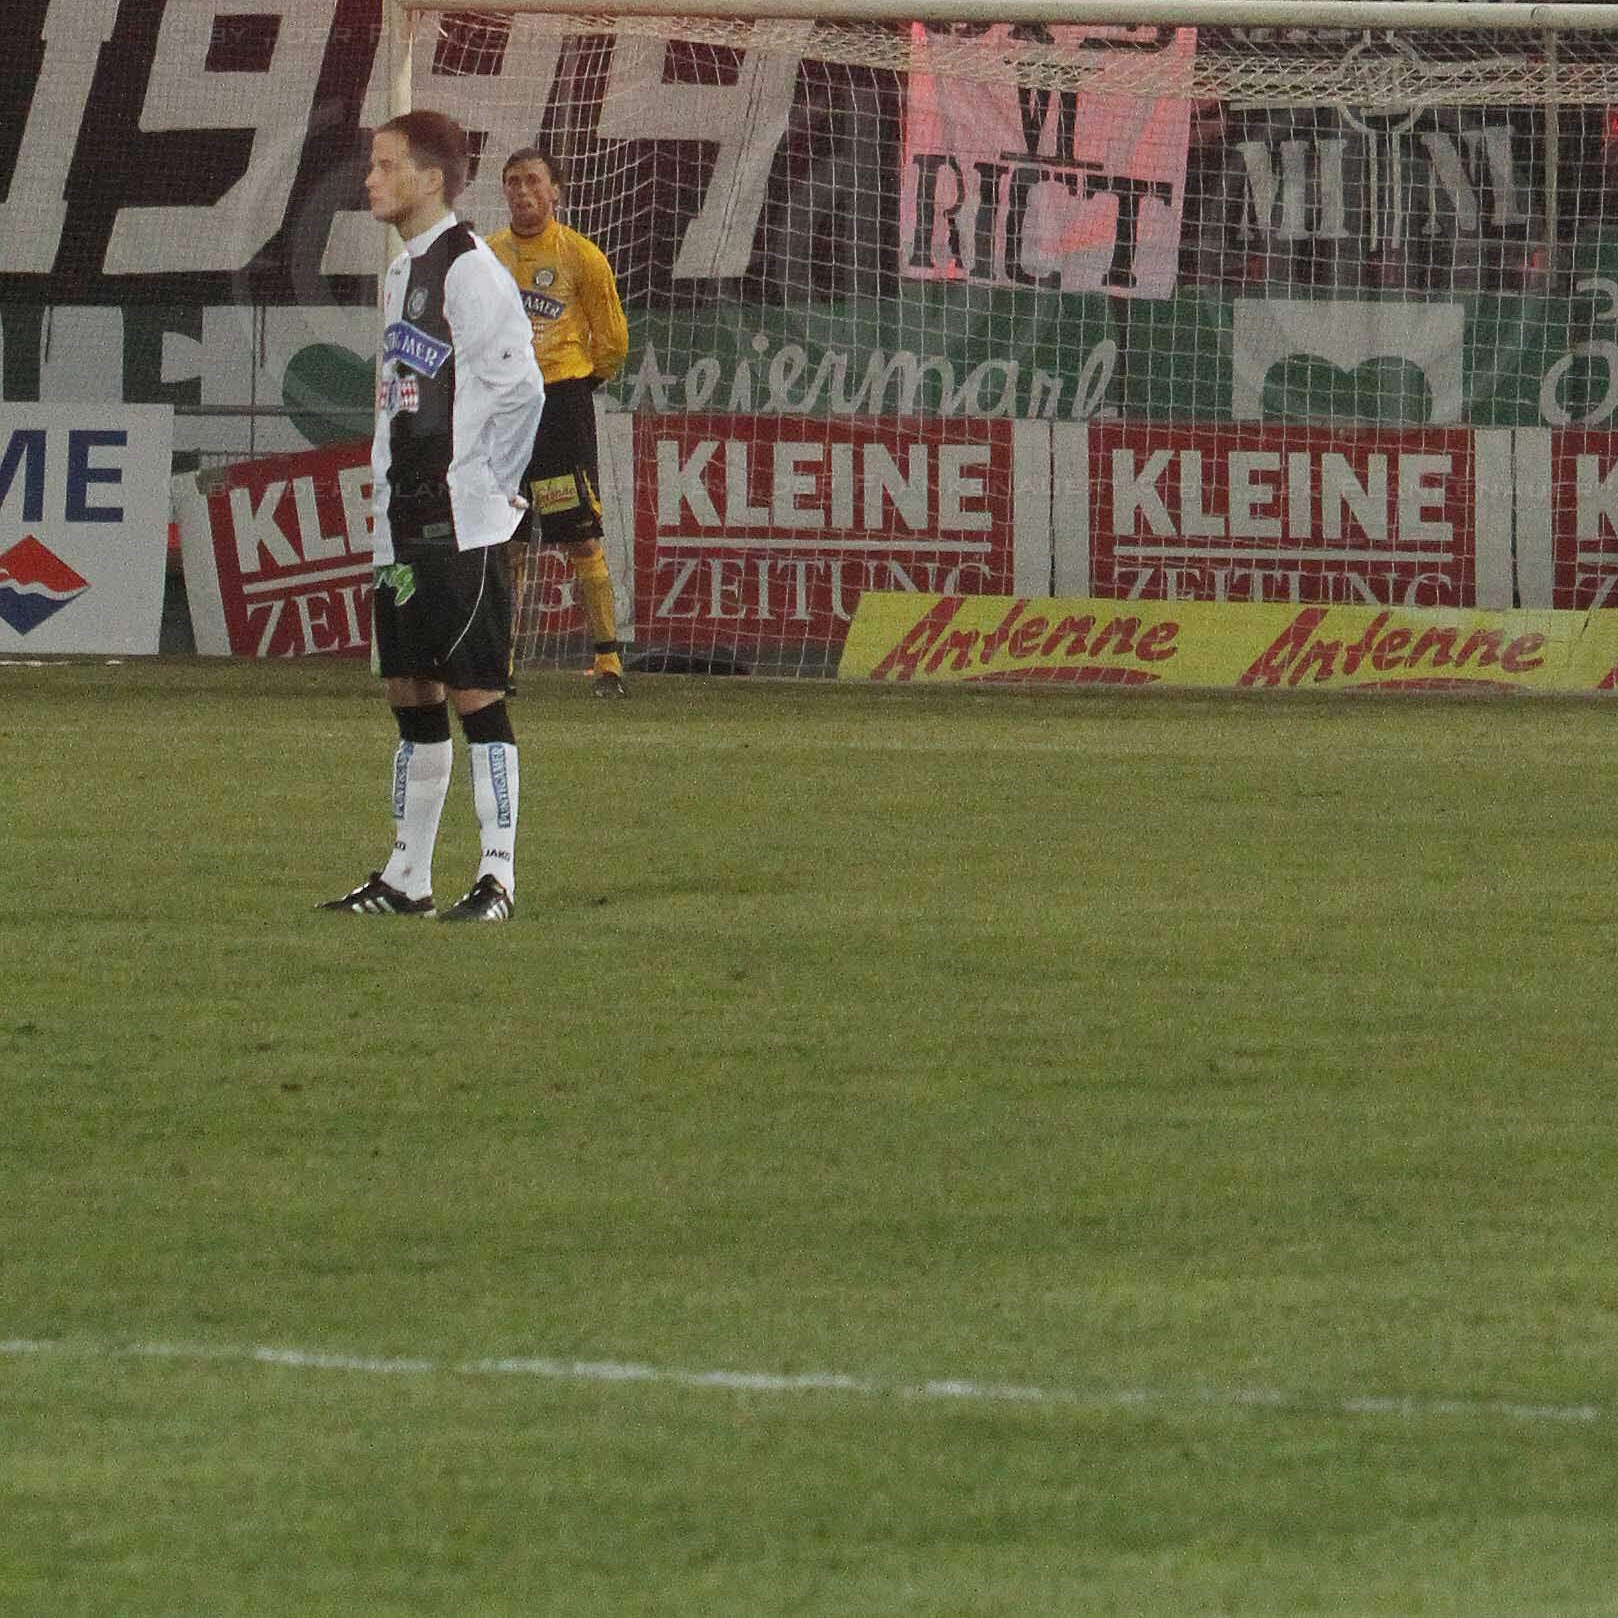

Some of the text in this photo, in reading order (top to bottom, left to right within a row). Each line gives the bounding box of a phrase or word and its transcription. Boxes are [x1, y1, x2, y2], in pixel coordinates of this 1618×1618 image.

[656, 439, 992, 531] KLEINE
[1112, 448, 1455, 544] KLEINE
[871, 597, 1181, 681] Antenne
[1240, 609, 1545, 686] Antenne
